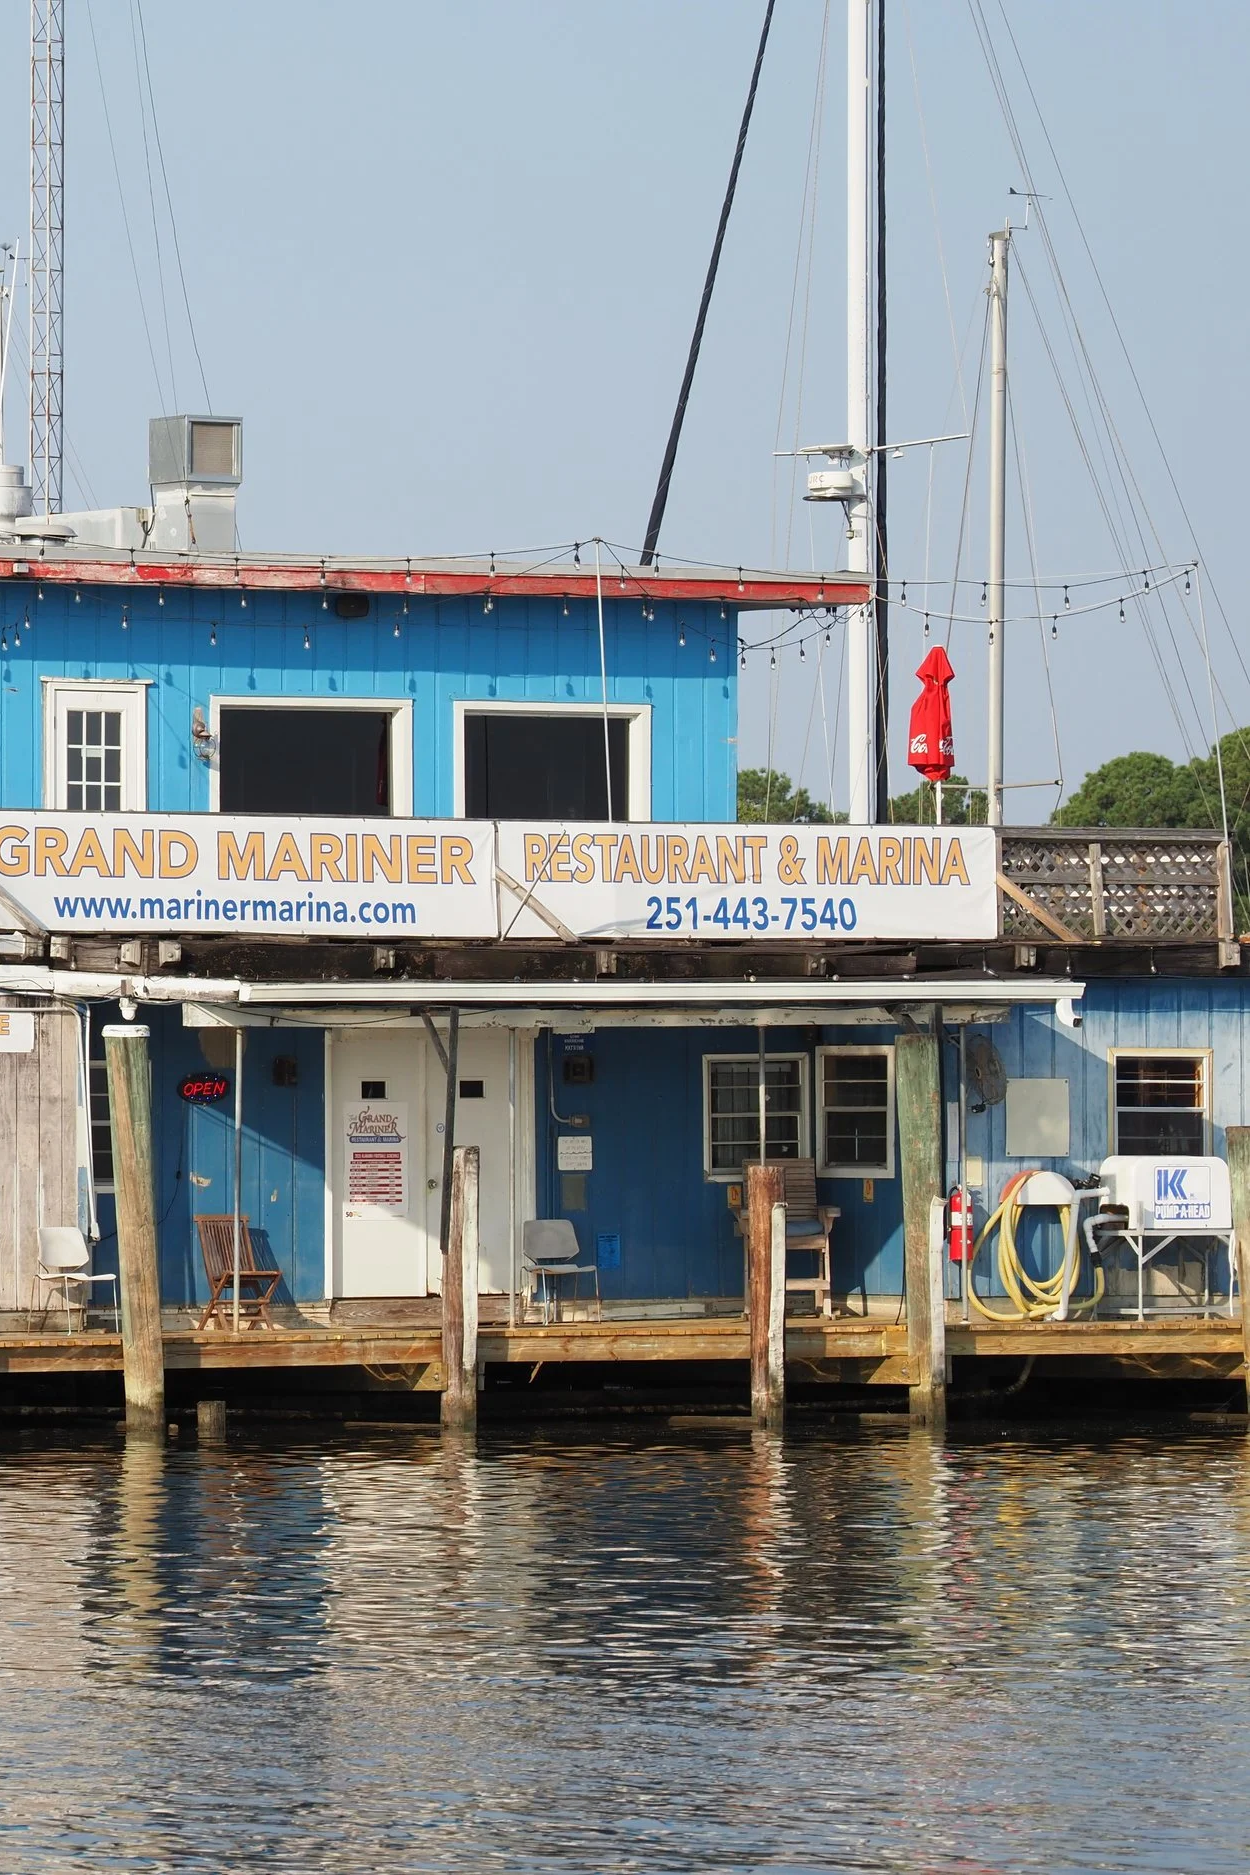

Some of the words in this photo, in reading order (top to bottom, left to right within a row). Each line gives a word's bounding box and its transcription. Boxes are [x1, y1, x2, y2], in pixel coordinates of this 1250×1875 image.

[216, 830, 477, 885] MARINER
[523, 832, 768, 885] RESTAURANT
[778, 834, 807, 885] &
[817, 836, 971, 887] MARINA
[53, 889, 417, 924] www.marinermarina.com
[646, 895, 858, 932] 251-443-7540
[183, 1081, 225, 1096] OPEN
[346, 1117, 407, 1139] MARINER
[358, 1105, 393, 1127] GRAND
[1155, 1204, 1210, 1219] PUMP-A-HEAD
